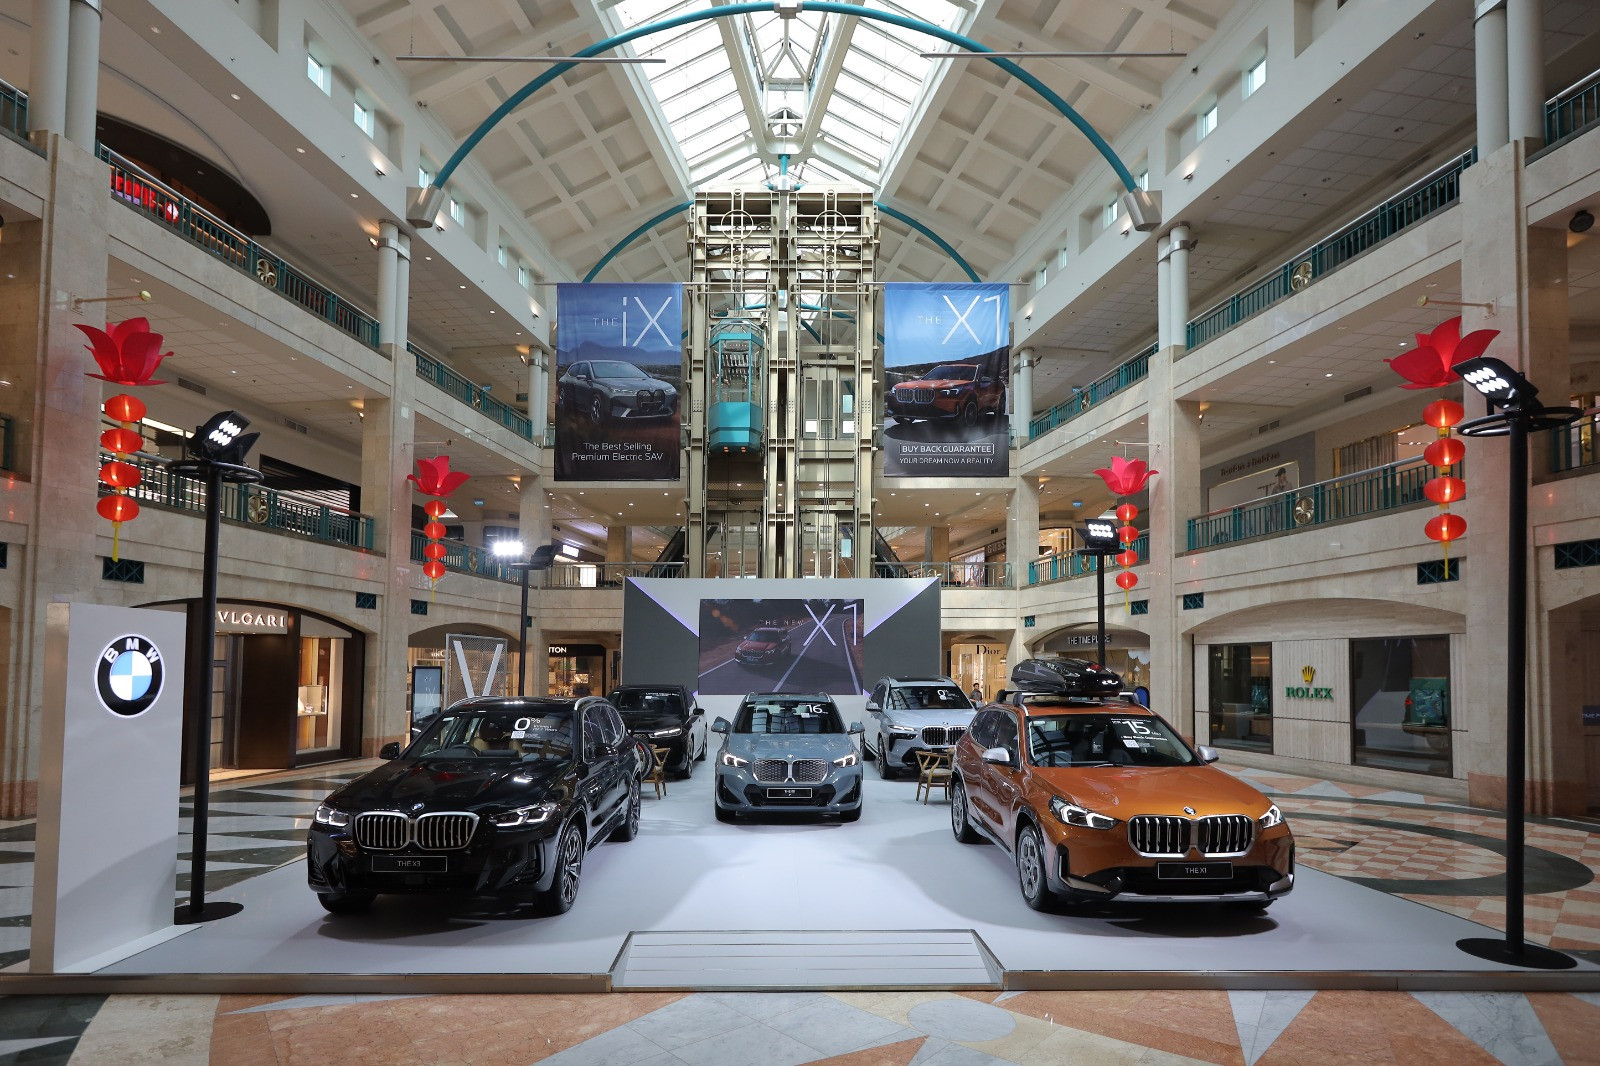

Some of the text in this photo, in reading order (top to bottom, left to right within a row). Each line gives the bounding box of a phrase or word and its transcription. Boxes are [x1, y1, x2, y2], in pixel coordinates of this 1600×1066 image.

[592, 296, 674, 347] THE iX
[917, 294, 1001, 346] THE X1
[583, 442, 652, 452] The Best Selling
[902, 445, 992, 453] BUY BACK GUARANTEE
[571, 452, 664, 461] Premium Electric SAV
[217, 610, 286, 628] VLGARI
[802, 603, 857, 647] X1
[1067, 636, 1078, 645] THE
[1091, 633, 1111, 644] PLE
[103, 637, 160, 664] BMW
[976, 644, 1001, 655] Dior
[1285, 686, 1334, 700] ROLEX
[805, 703, 823, 714] 16
[1121, 720, 1151, 735] 15
